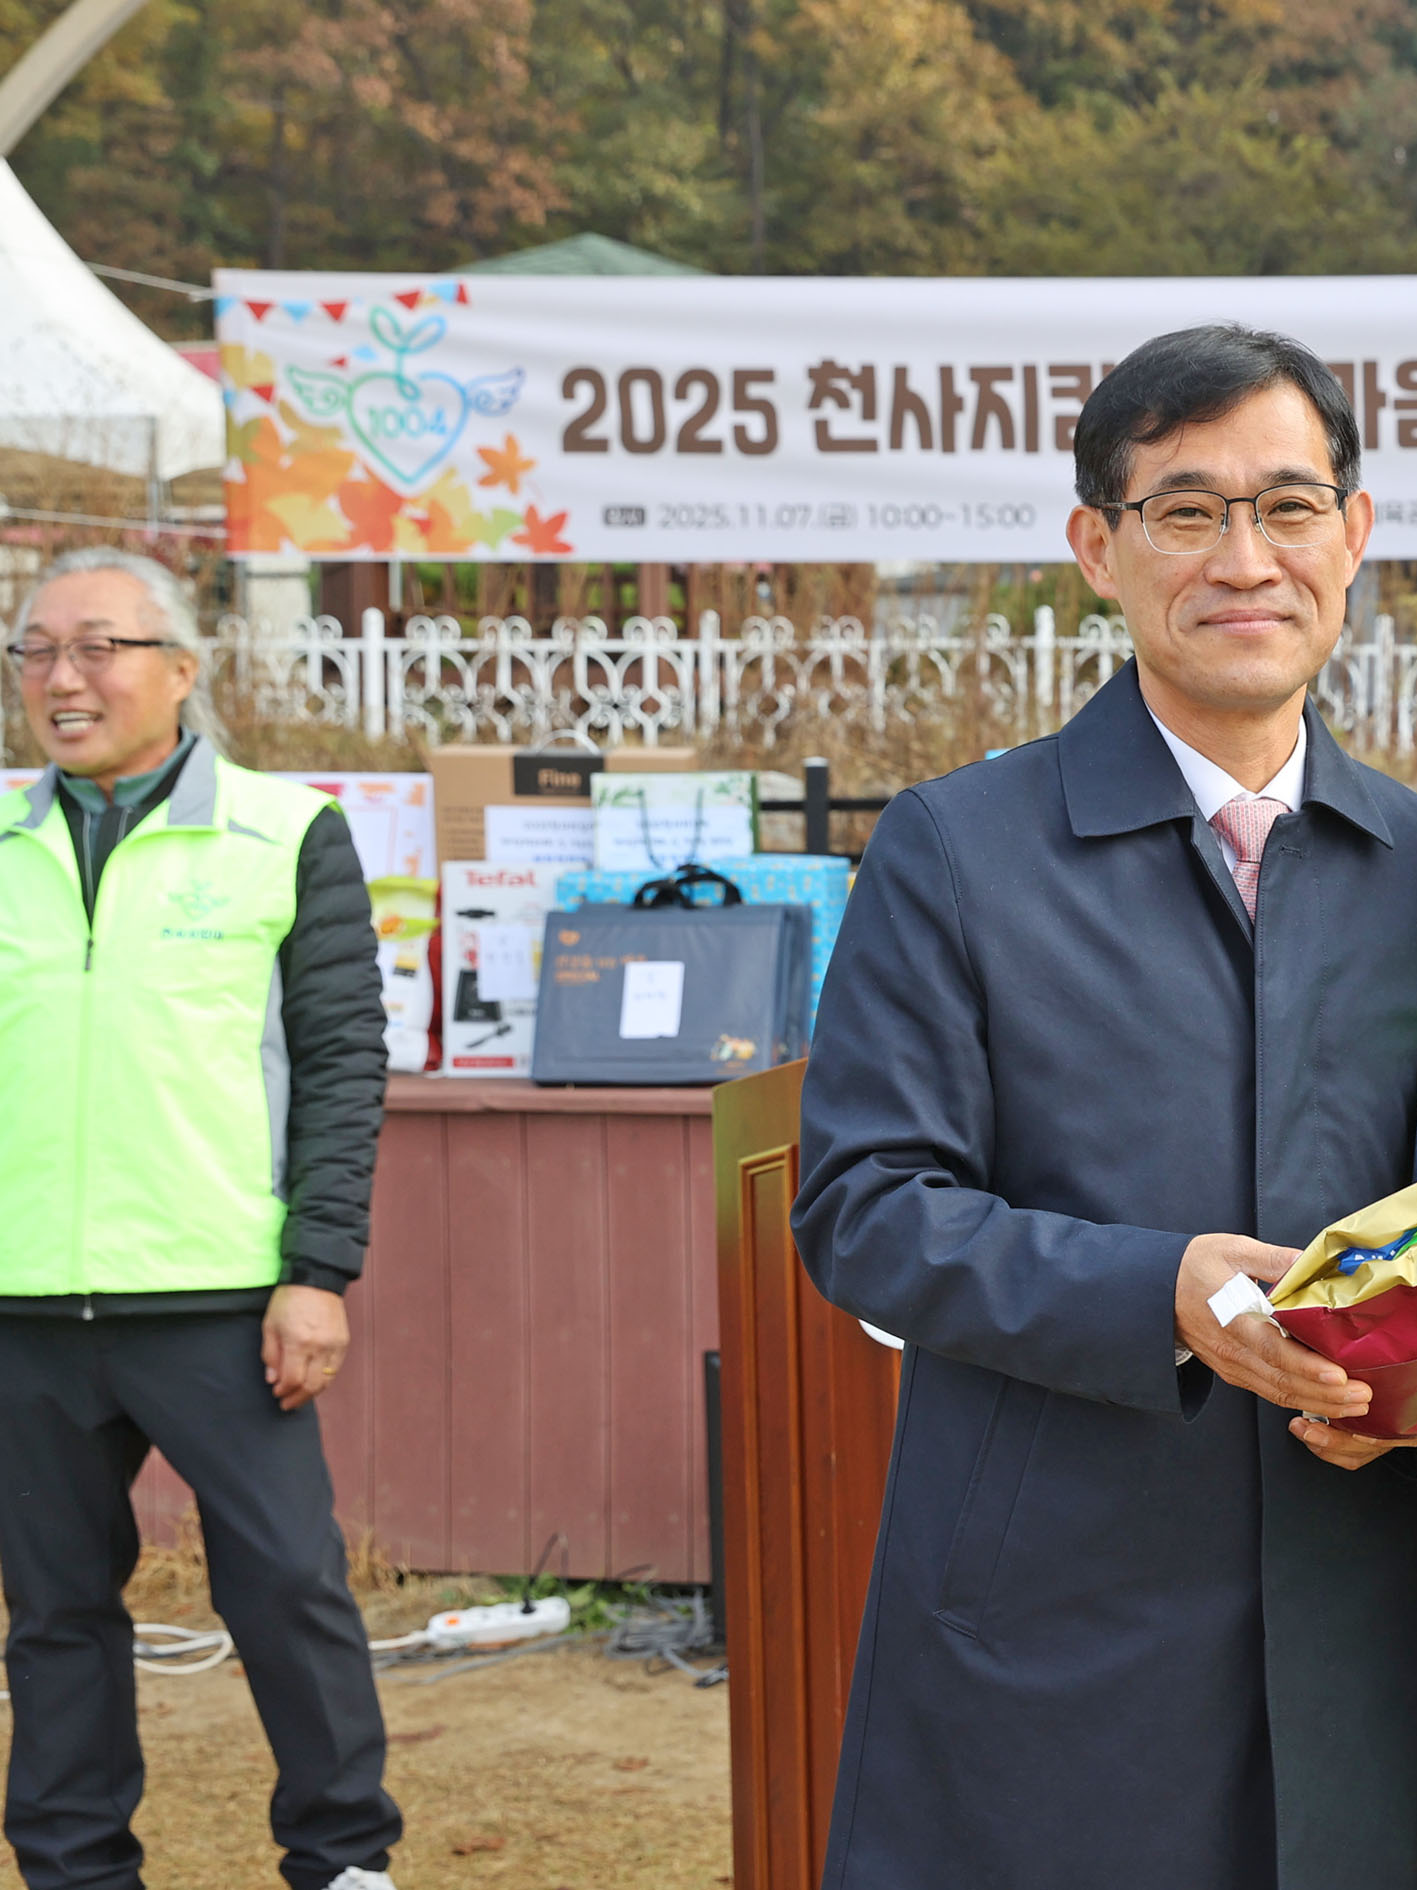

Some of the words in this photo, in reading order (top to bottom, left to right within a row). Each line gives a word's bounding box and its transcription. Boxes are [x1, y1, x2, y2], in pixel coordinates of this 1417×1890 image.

[561, 366, 779, 456] 2025
[807, 358, 1115, 454] 천사지킴
[367, 406, 447, 438] 1004
[538, 769, 582, 788] Fine
[466, 869, 536, 887] Tefal
